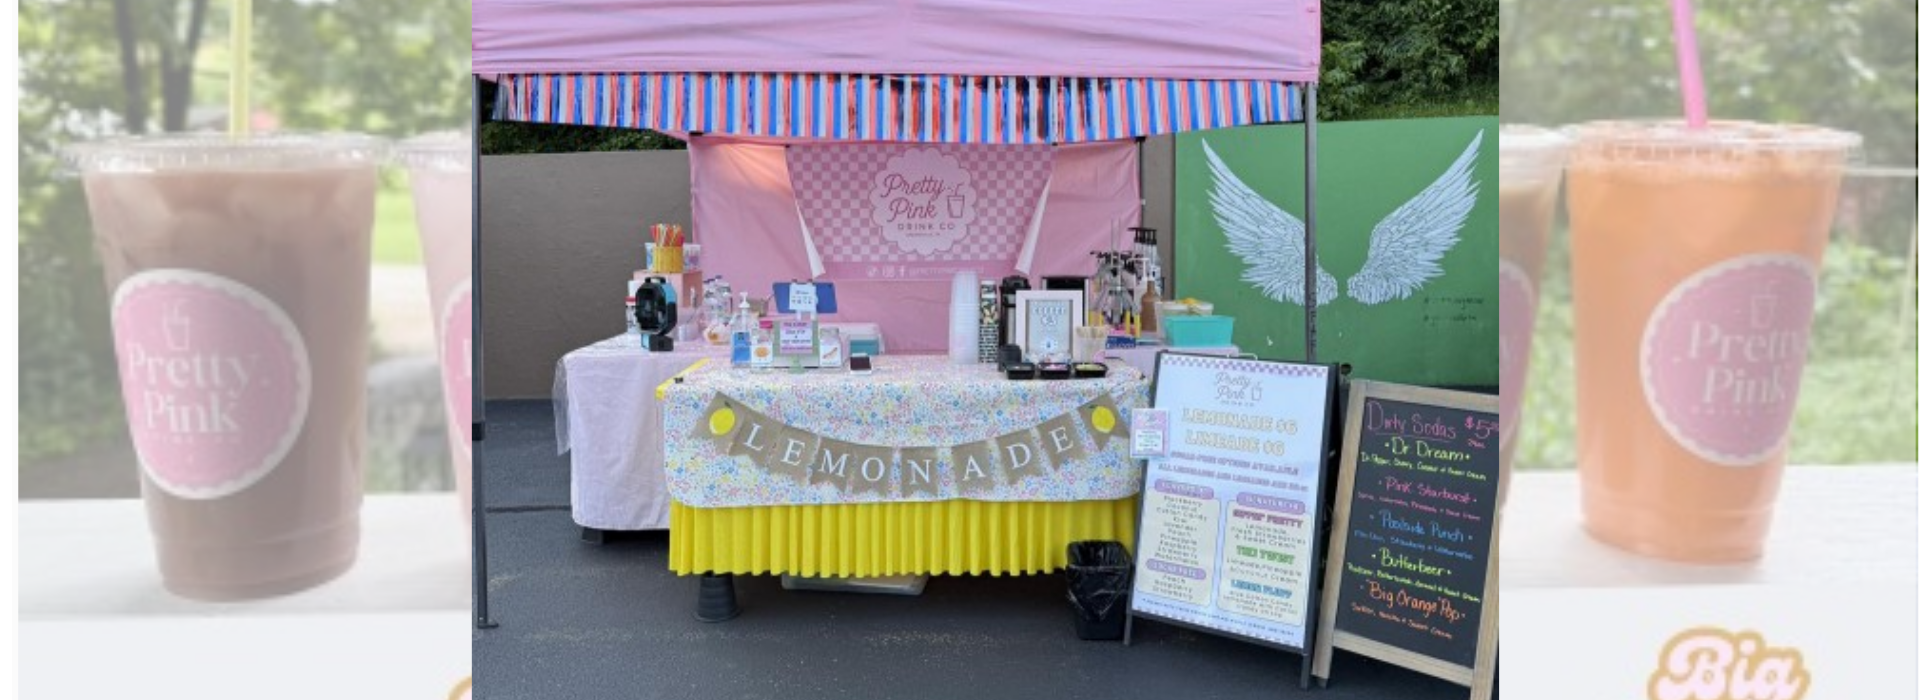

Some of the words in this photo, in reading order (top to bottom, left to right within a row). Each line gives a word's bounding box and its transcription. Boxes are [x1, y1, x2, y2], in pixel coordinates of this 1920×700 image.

[880, 173, 944, 200] Pretty
[886, 197, 937, 223] Pink
[897, 222, 935, 231] DRINK
[939, 222, 956, 231] CO
[125, 341, 248, 397] Pretty
[1215, 372, 1250, 388] Pretty
[1215, 386, 1246, 400] Pink
[1703, 365, 1786, 404] Pink
[143, 390, 241, 434] Pink
[1367, 400, 1406, 434] Dirty
[1411, 413, 1456, 439] Sodas
[743, 423, 1075, 484] LEMONADE
[1391, 436, 1409, 455] Dr
[1416, 440, 1464, 460] Dream
[1430, 520, 1464, 542] Punch
[1379, 547, 1446, 576] Butterbeer
[1366, 578, 1394, 608] Big
[1396, 588, 1437, 618] Orange
[1438, 596, 1460, 624] Pop
